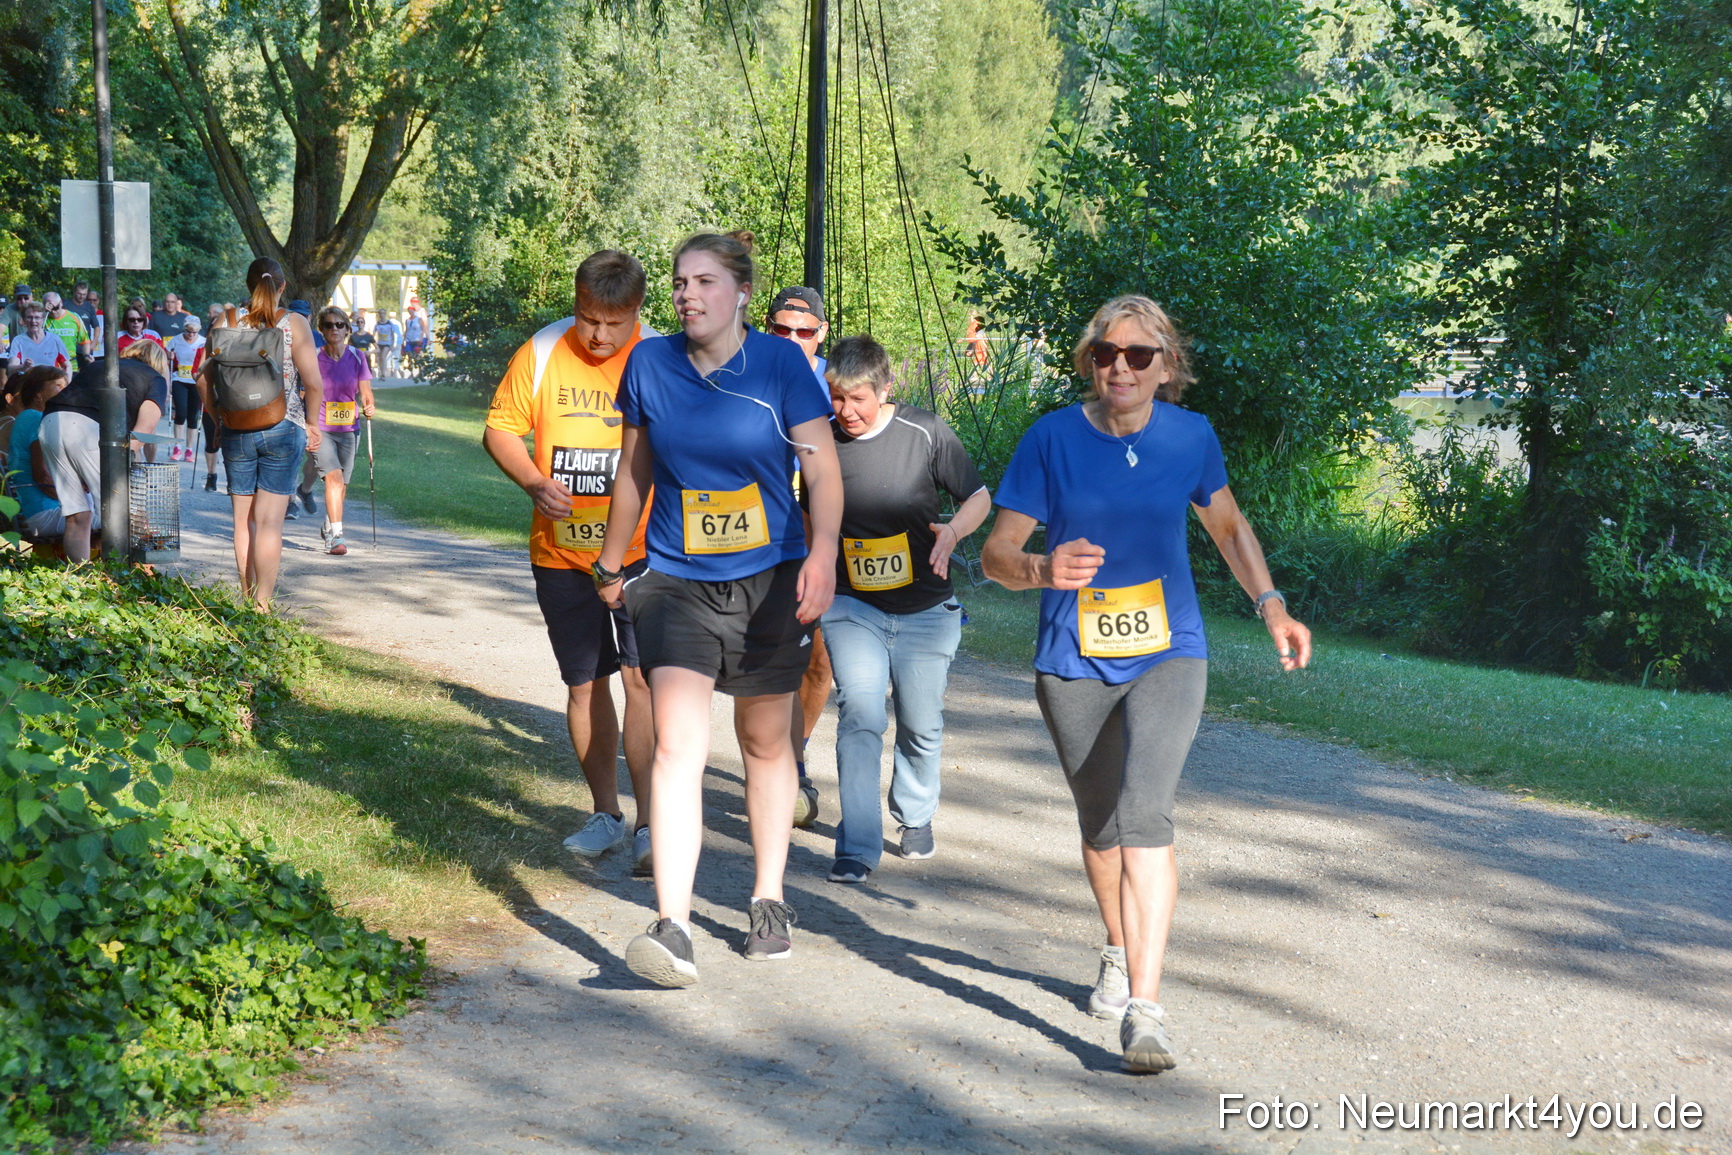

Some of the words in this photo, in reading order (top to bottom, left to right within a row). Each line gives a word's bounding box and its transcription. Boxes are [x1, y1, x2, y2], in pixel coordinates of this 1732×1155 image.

[557, 385, 569, 405] BIT
[333, 410, 350, 418] 460
[554, 449, 609, 471] #LÄUFT
[577, 475, 606, 493] UNS
[701, 511, 750, 536] 674
[853, 555, 903, 576] 1670
[1098, 611, 1149, 637] 668
[1133, 634, 1158, 642] Monika
